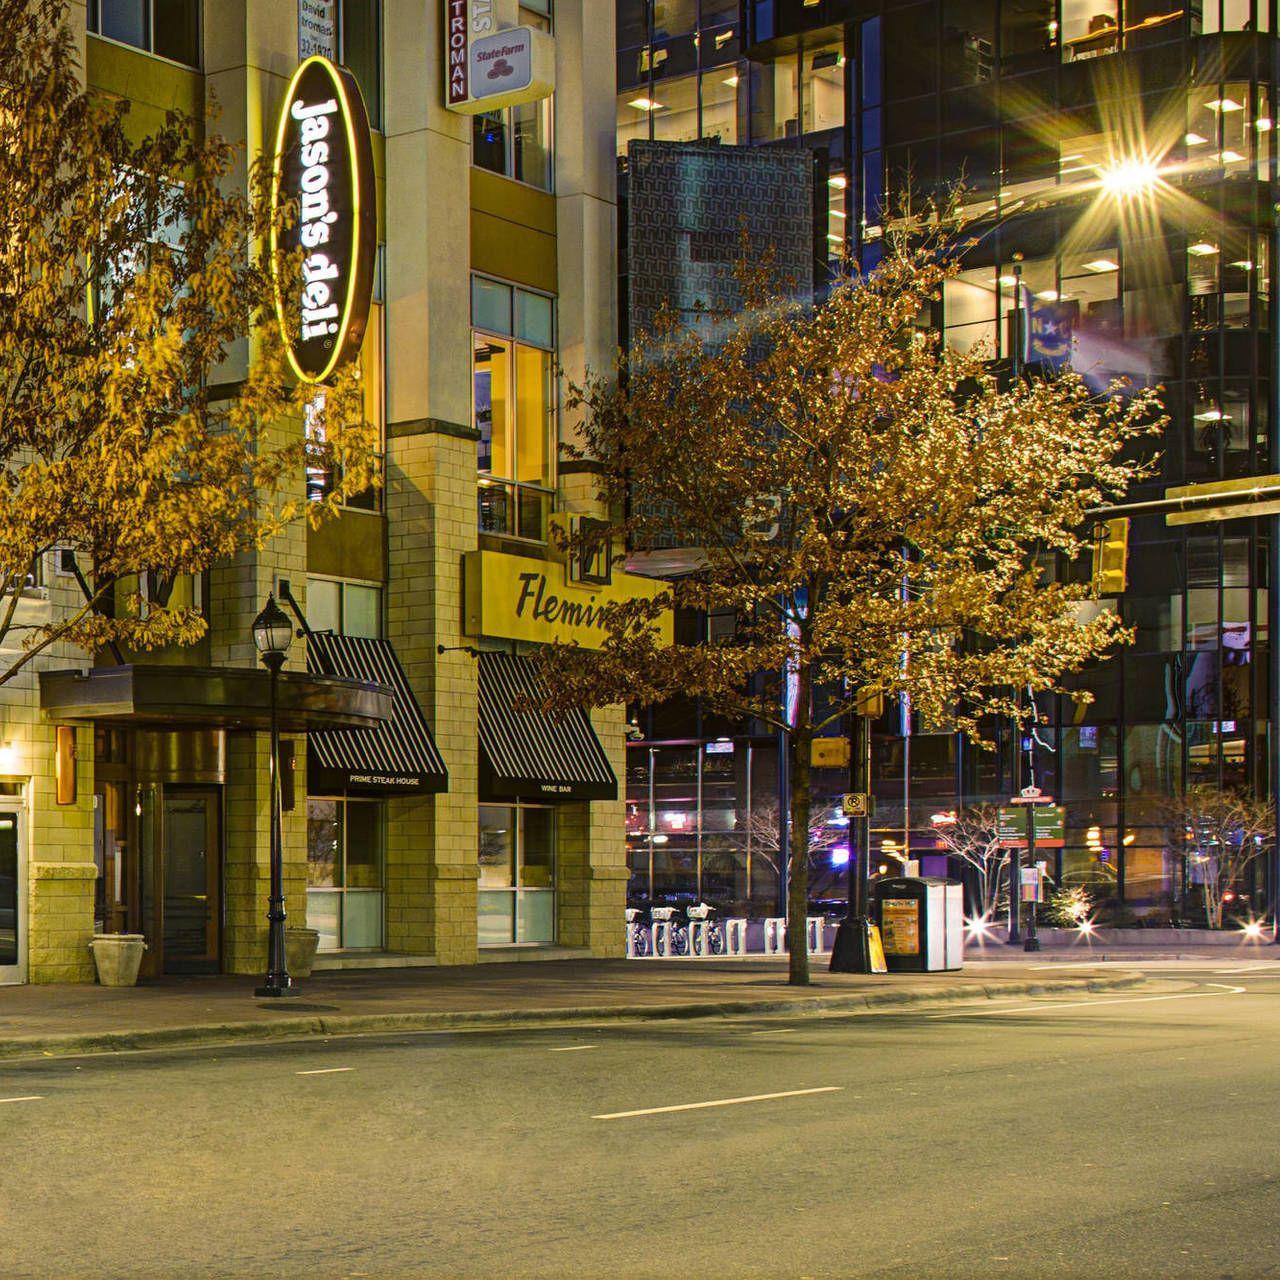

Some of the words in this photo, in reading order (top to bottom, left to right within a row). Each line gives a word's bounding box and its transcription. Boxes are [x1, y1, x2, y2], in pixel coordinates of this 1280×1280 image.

[291, 98, 339, 248] Jason's
[301, 252, 340, 342] deli
[349, 774, 372, 784] PRIME
[372, 776, 395, 785] STEAK
[396, 777, 420, 786] HOUSE
[541, 784, 558, 793] WINE
[559, 785, 572, 793] BAR
